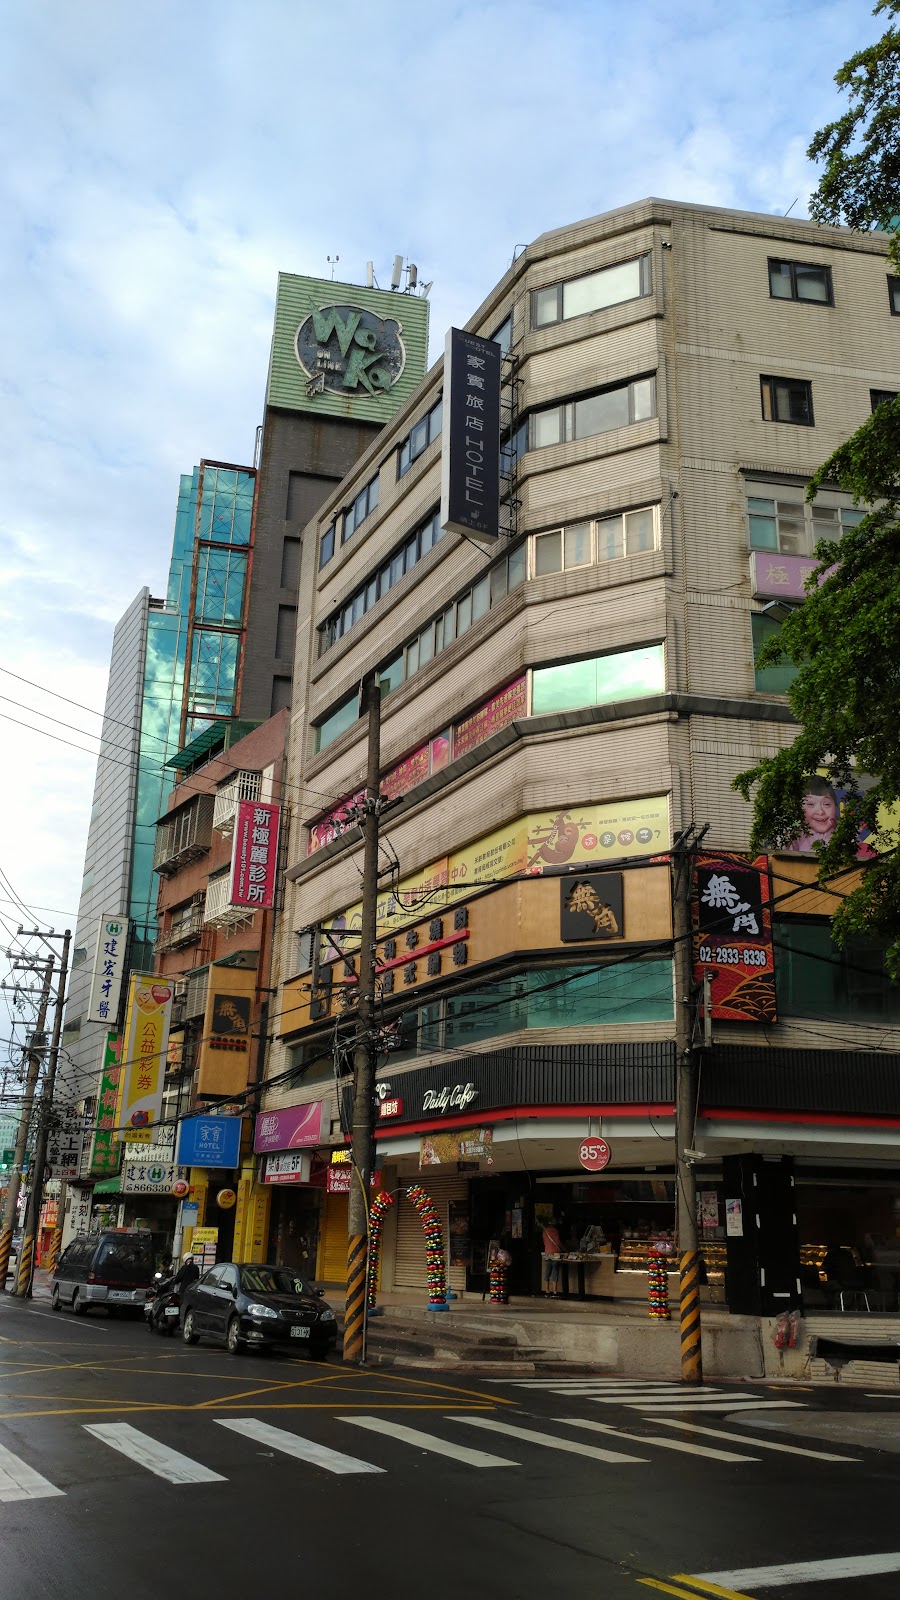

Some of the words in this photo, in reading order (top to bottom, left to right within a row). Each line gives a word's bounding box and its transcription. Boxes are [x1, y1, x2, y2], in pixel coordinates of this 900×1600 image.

[316, 360, 342, 372] LINE
[465, 435, 485, 507] HOTEL
[246, 807, 272, 904] 新極麗診所
[699, 945, 767, 966] 02-2933-8336
[96, 938, 119, 1020] 建宏牙醫
[136, 1021, 158, 1091] 公益彩券
[422, 1086, 451, 1113] Daily
[449, 1082, 479, 1110] Cafe
[198, 1142, 220, 1150] HOTEL
[291, 1155, 301, 1171] 5F
